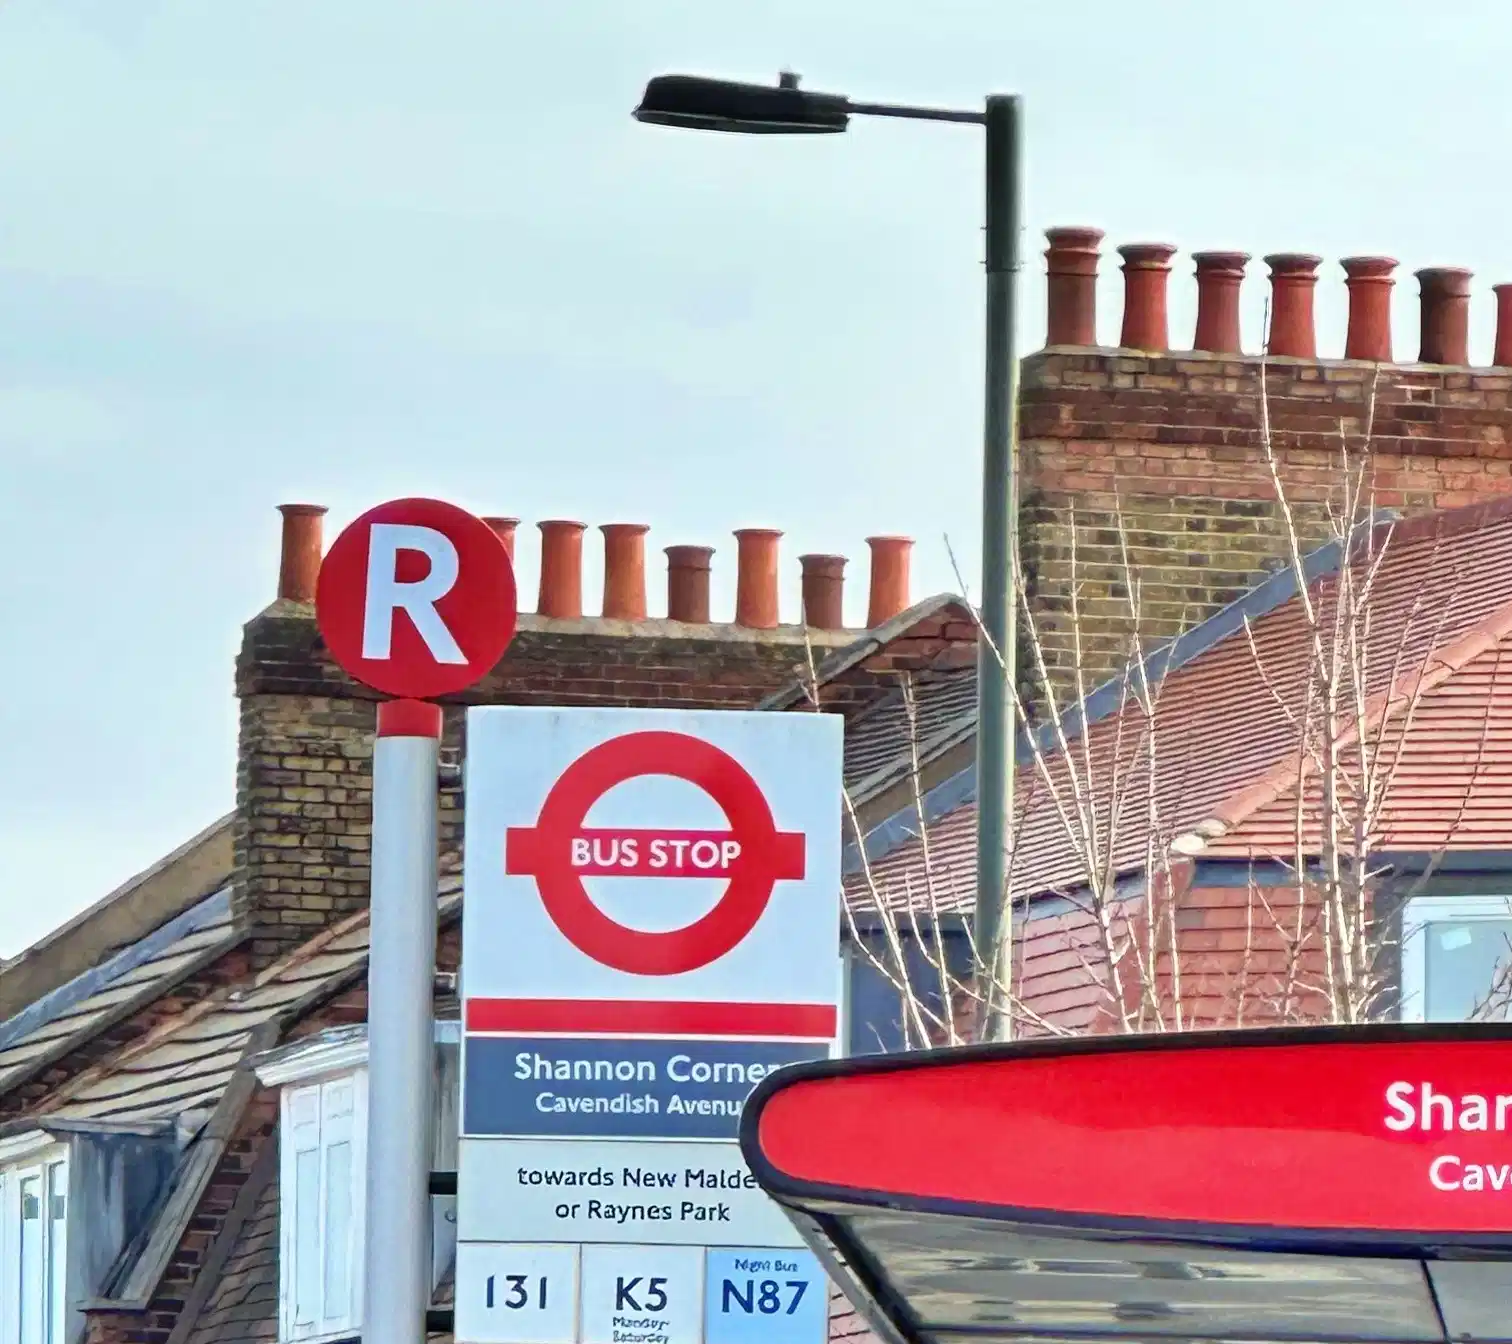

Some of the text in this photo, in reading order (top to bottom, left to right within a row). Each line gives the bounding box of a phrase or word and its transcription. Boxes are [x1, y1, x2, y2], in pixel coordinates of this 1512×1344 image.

[361, 523, 469, 665] R
[571, 838, 741, 869] BUS STOP
[514, 1053, 656, 1081] Shannon
[535, 1092, 742, 1116] Cavendish Avenu
[518, 1167, 759, 1189] towards New Malde
[555, 1200, 730, 1223] or Raynes Park
[486, 1275, 547, 1310] 131
[616, 1277, 668, 1312] K5
[722, 1279, 809, 1315] N87
